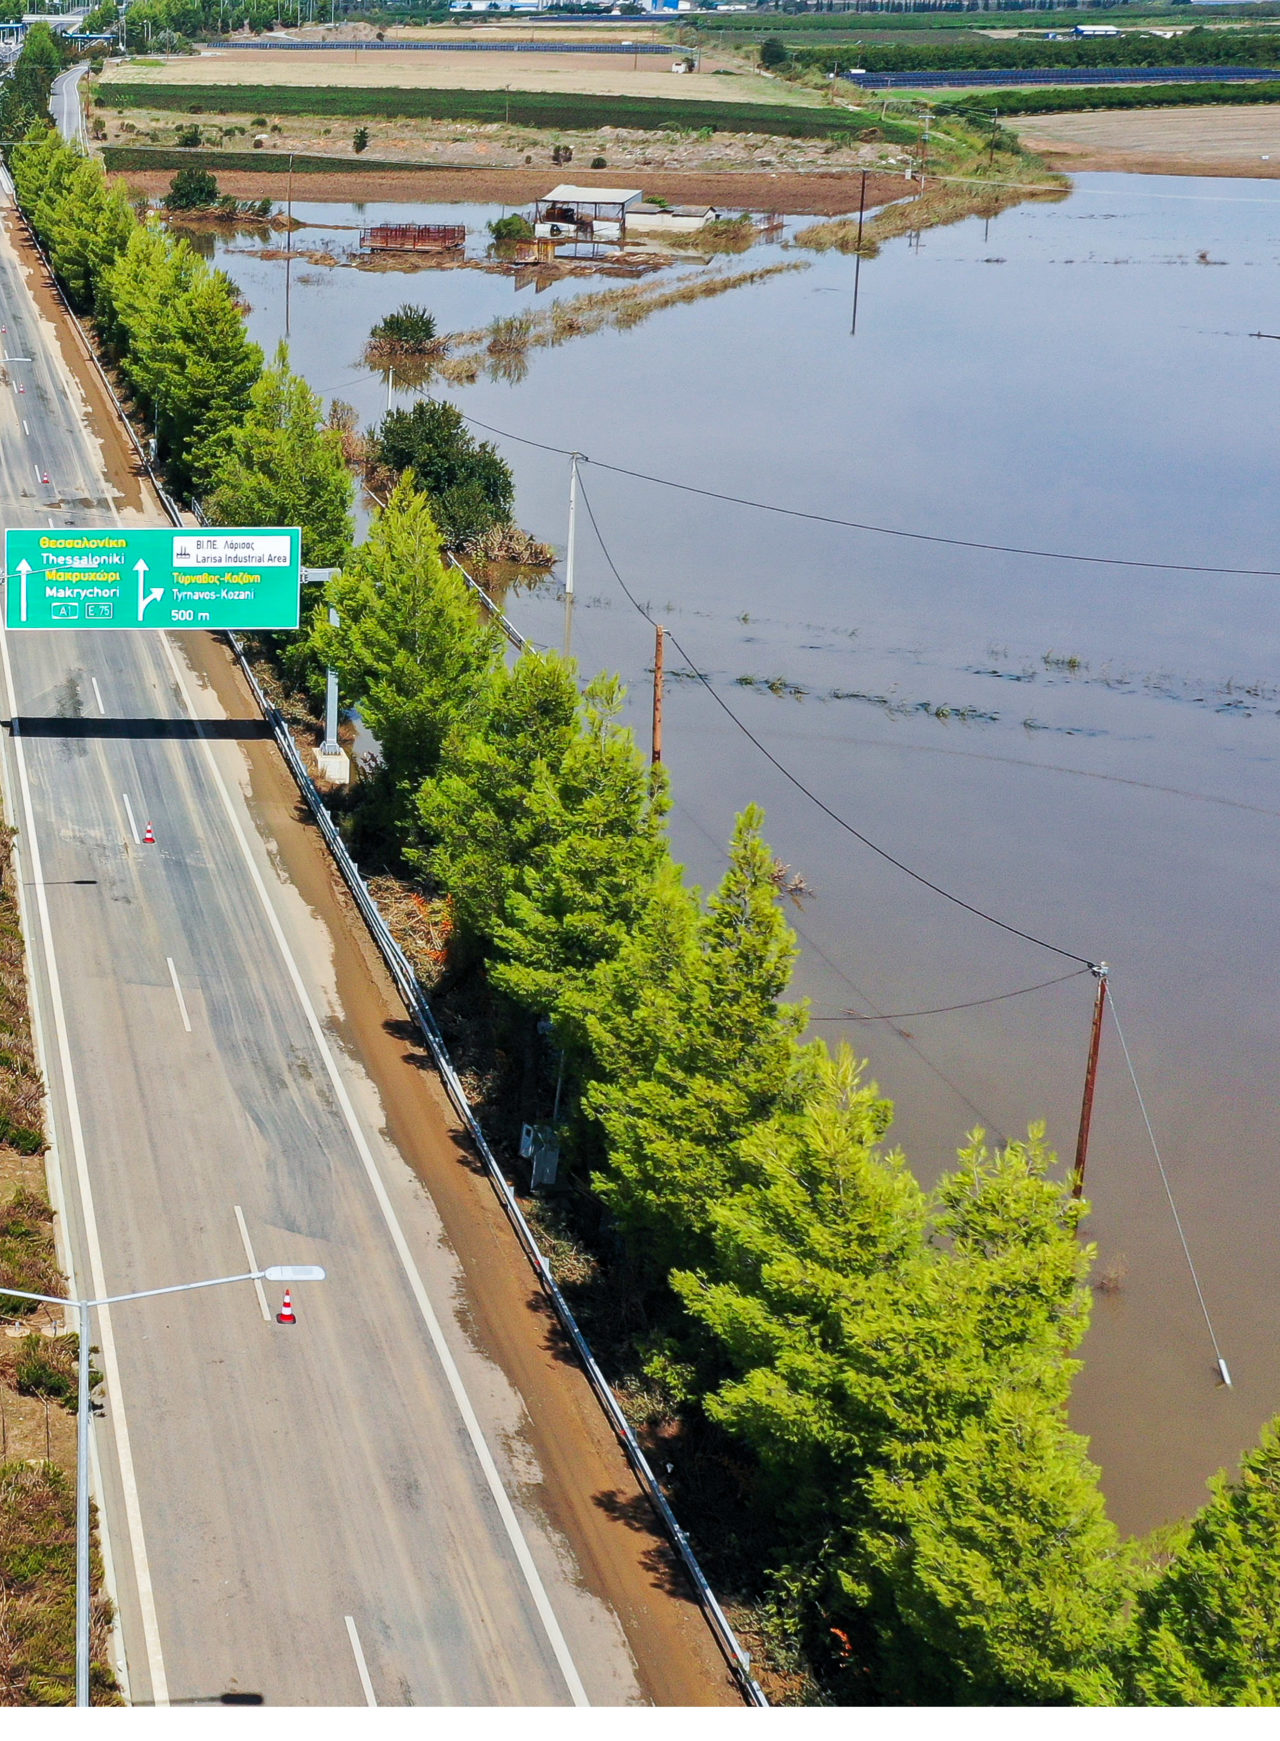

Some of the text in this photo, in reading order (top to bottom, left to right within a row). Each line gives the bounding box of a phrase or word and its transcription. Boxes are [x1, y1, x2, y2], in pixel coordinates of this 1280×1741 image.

[39, 536, 126, 548] Θεσσαλονίκη
[41, 553, 125, 564] Thessaloniki
[196, 554, 287, 563] Larisa Industrial Area
[45, 570, 121, 583] Μακρυχώρι
[45, 586, 120, 600] Makrychori
[172, 588, 255, 601] Tyrnavos-Kozani
[59, 606, 72, 616] A1
[88, 605, 110, 616] E 75
[171, 610, 210, 621] 500 m
